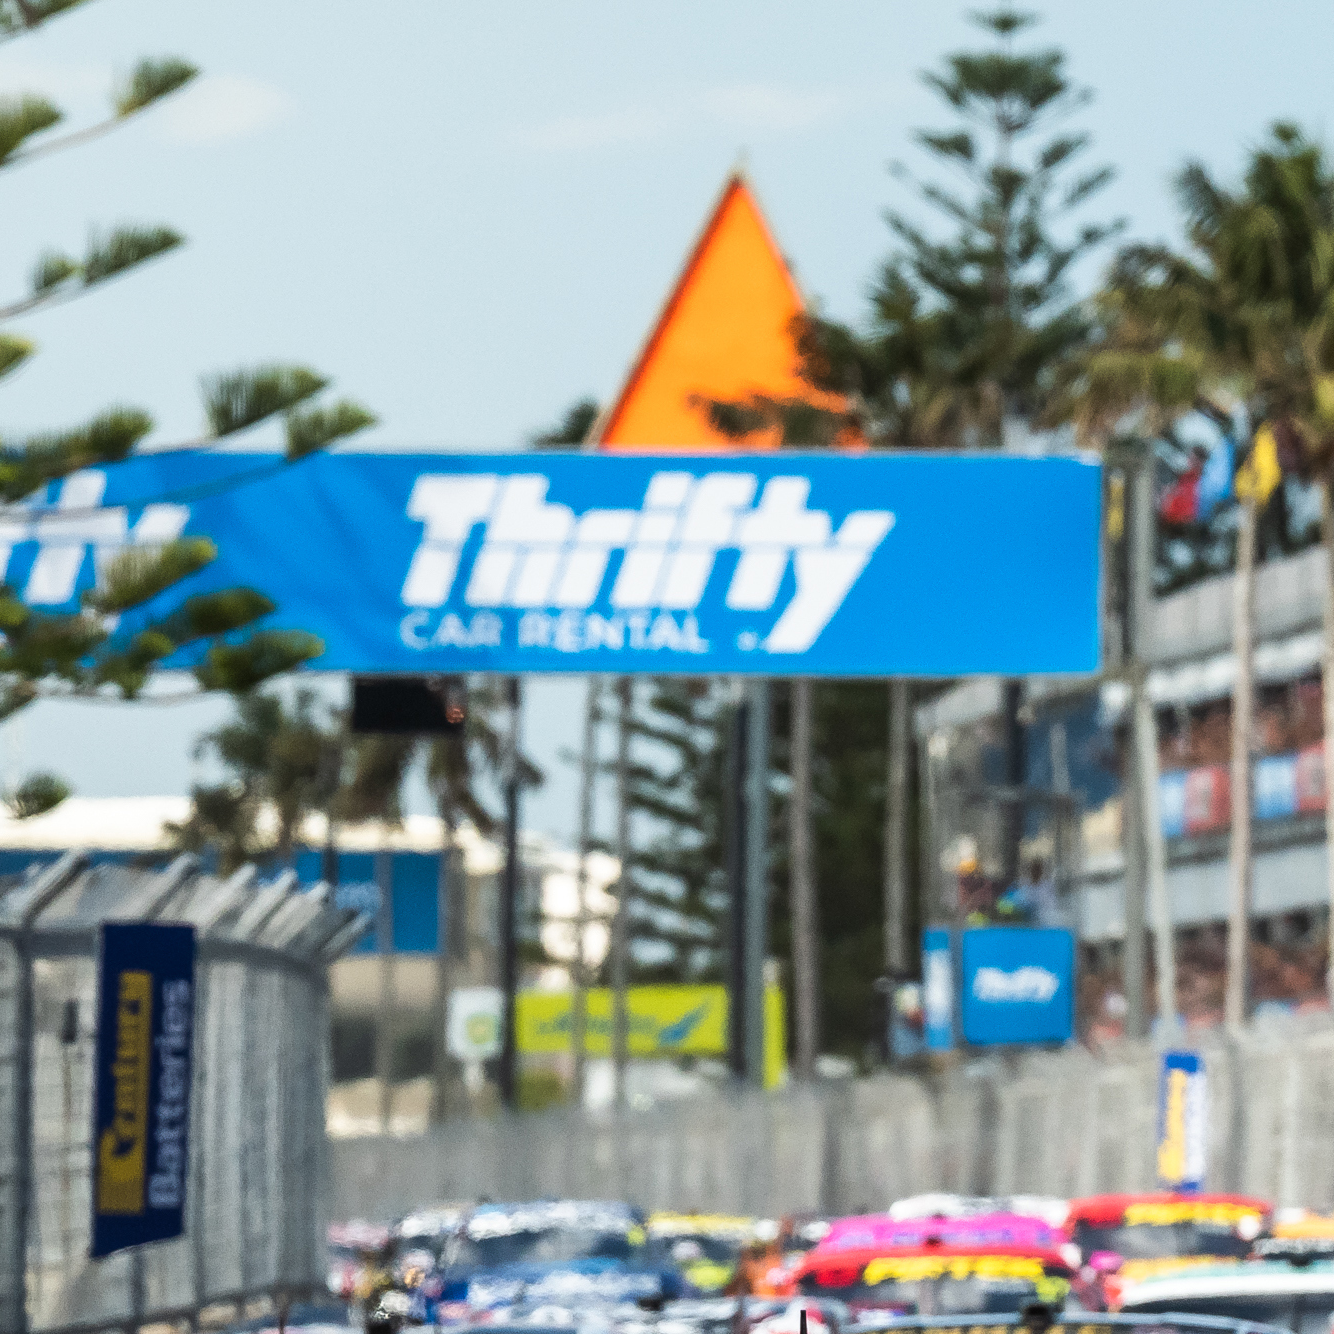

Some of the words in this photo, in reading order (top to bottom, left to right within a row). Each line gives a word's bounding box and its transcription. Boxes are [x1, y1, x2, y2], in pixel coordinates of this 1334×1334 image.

[402, 472, 897, 655] Thrifty
[398, 609, 501, 652] CAR
[519, 609, 713, 655] RENTAL
